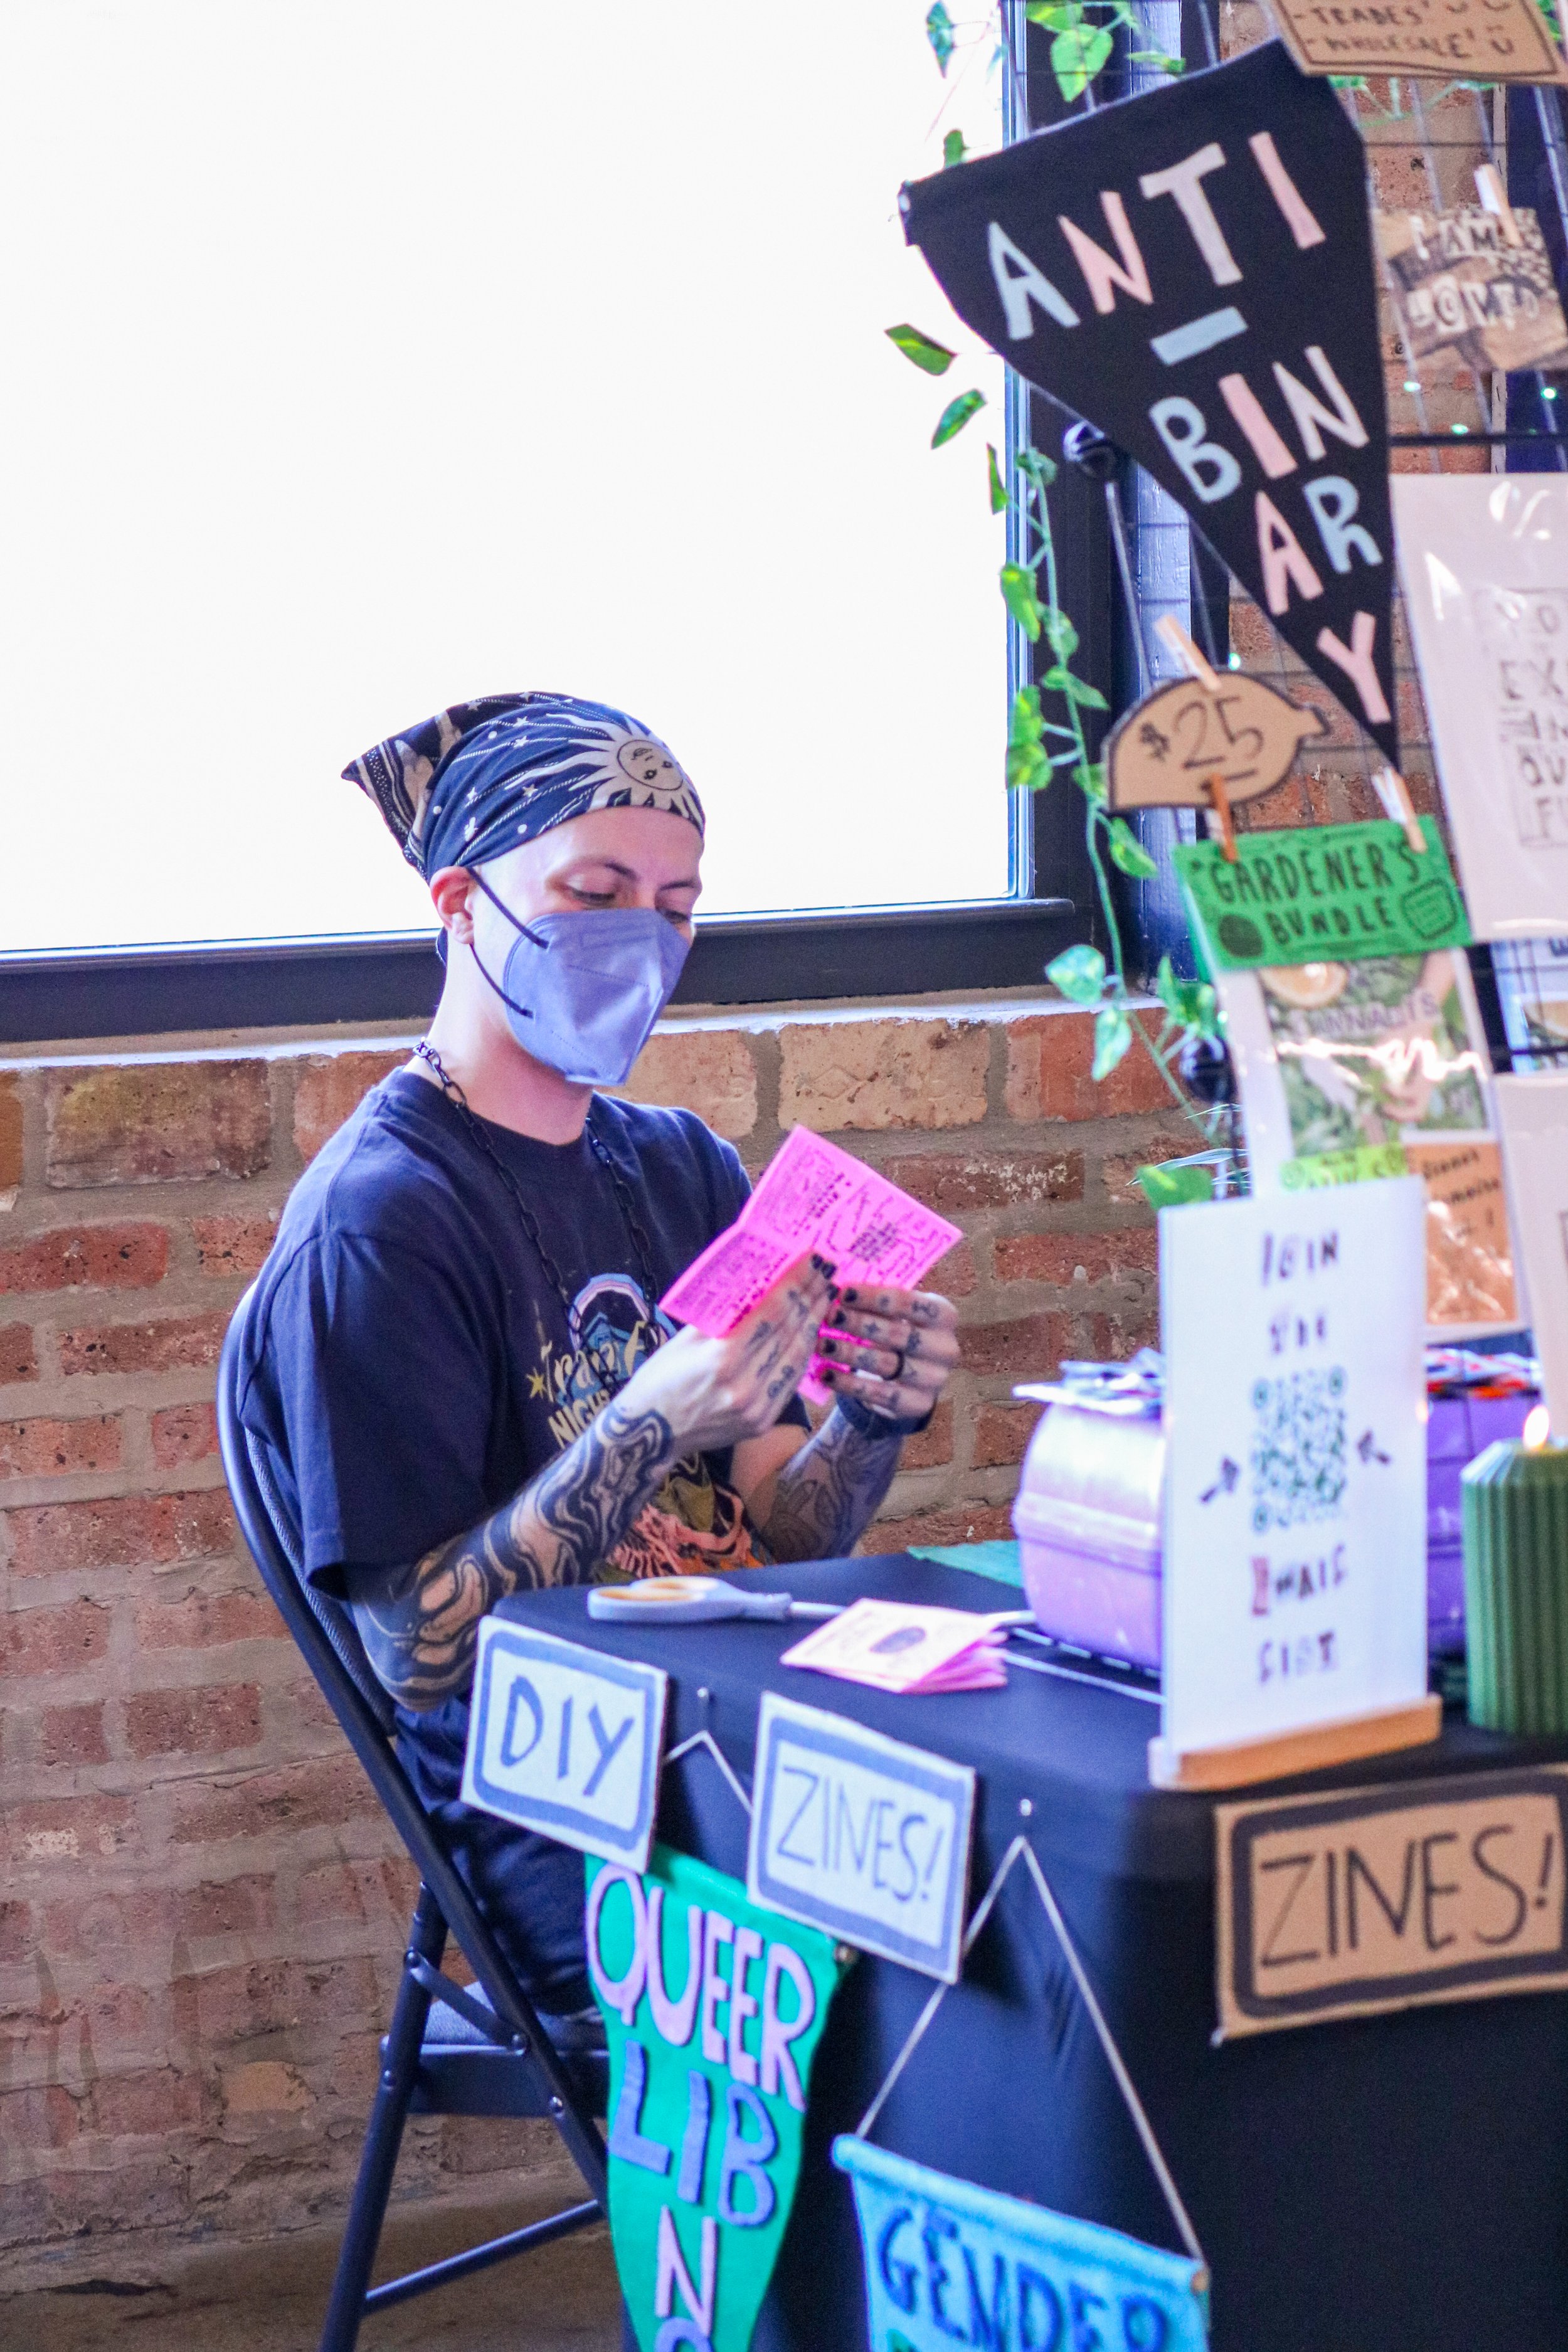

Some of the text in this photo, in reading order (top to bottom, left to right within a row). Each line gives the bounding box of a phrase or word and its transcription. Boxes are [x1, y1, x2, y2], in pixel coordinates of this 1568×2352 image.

[988, 131, 1327, 341] ANTI
[1139, 695, 1264, 770] $25
[1264, 895, 1395, 945] BUNDLE
[500, 1674, 635, 1797] DIY
[776, 1764, 945, 1903] ZINES!
[1258, 1823, 1554, 1968] ZINES!
[586, 1863, 815, 2112] QUEER
[608, 2038, 778, 2227] LIB
